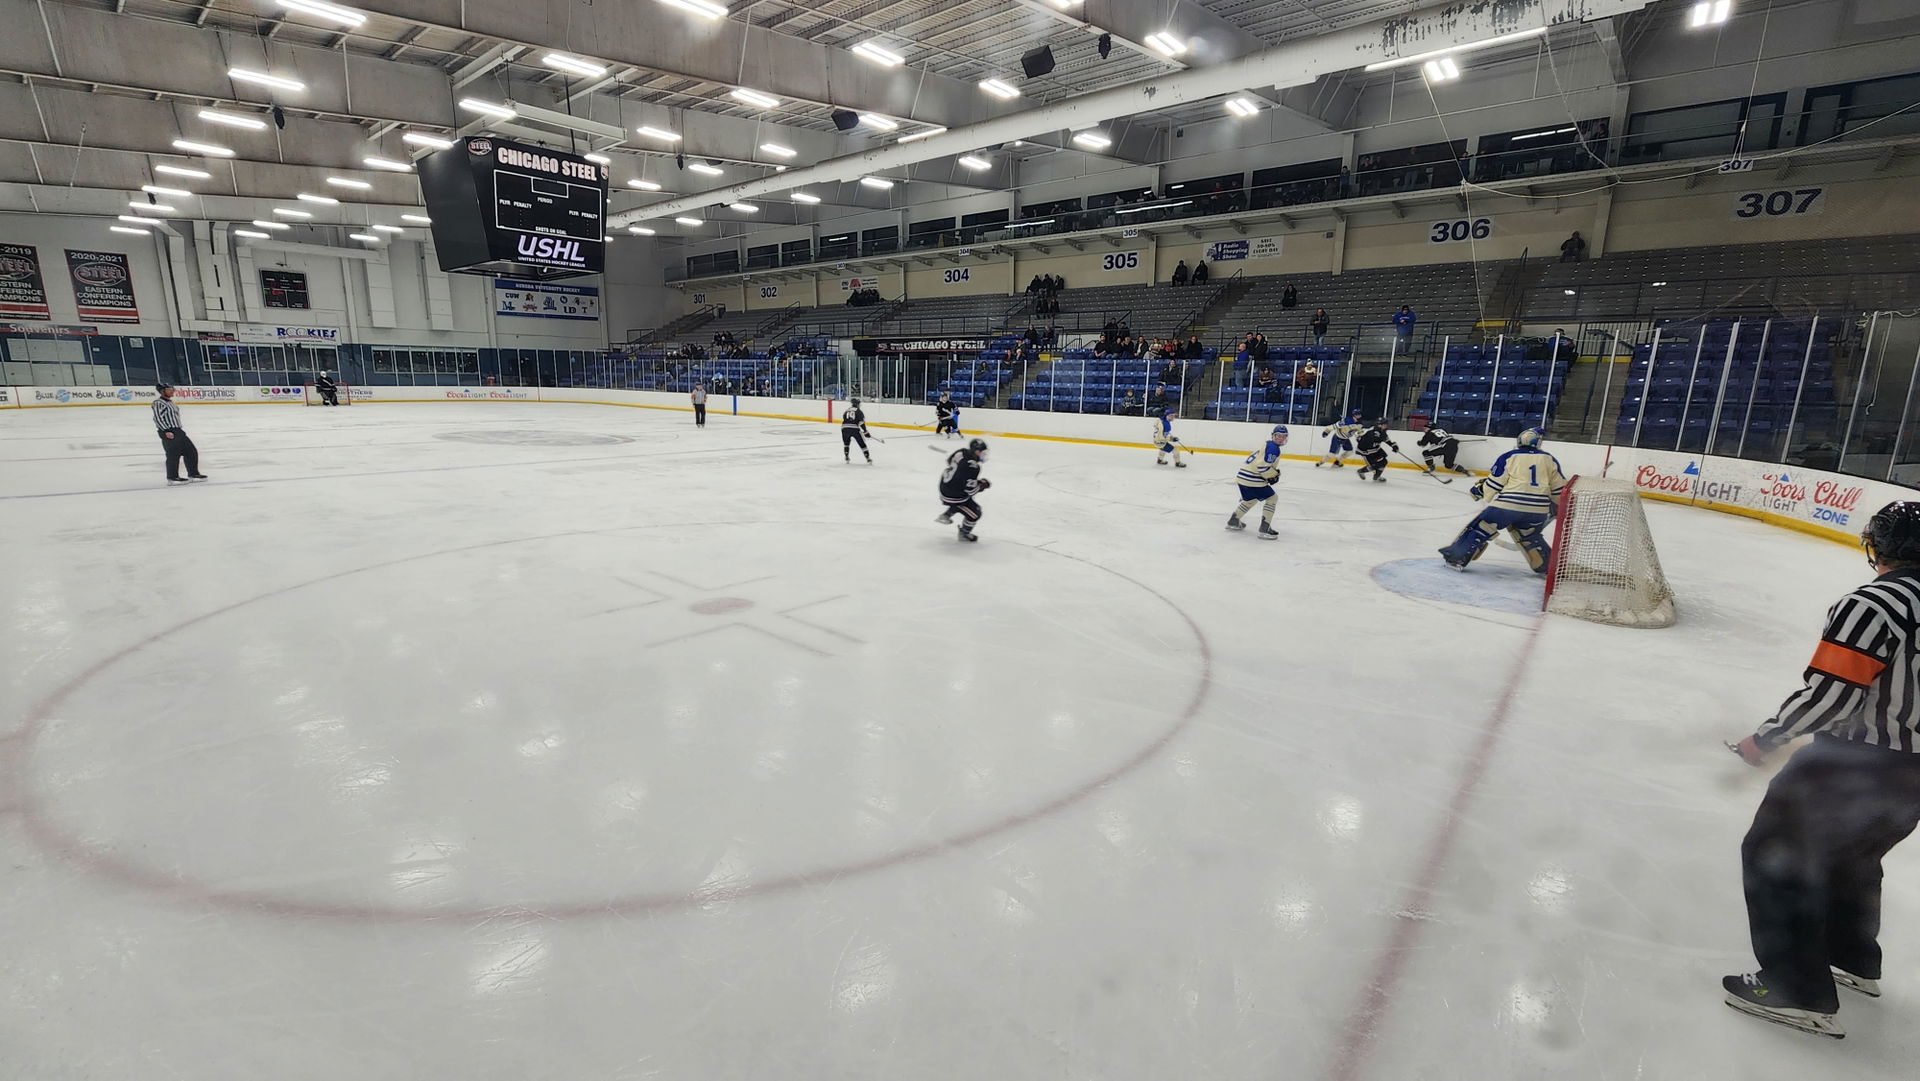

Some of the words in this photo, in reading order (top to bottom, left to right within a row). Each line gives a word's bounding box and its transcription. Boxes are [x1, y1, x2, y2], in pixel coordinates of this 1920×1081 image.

[470, 142, 491, 150] STEEL
[497, 147, 559, 174] CHICAGO
[561, 160, 598, 181] STEEL
[1720, 160, 1753, 171] 307
[513, 201, 532, 209] PENALTY
[1737, 188, 1822, 218] 307
[1123, 229, 1138, 237] 305
[1430, 218, 1491, 243] 306
[518, 235, 585, 261] USHL
[71, 252, 123, 263] 2020-2021
[1103, 252, 1138, 270] 305
[79, 266, 122, 279] STEEL
[944, 268, 970, 283] 304
[84, 286, 123, 294] EASTERN
[761, 286, 777, 298] 302
[77, 292, 134, 301] CONFERENCE
[693, 294, 706, 304] 301
[81, 299, 132, 307] CHAMPIONS
[9, 323, 71, 335] Souvenirs
[276, 327, 337, 338] ROOKIES
[903, 340, 949, 350] CHICAGO
[950, 340, 986, 350] STEEL
[35, 391, 54, 399] BLUE
[96, 390, 115, 399] BLUE
[175, 388, 236, 399] alphagraphics
[1529, 464, 1539, 487] 1
[1635, 465, 1689, 494] Coors
[1691, 479, 1742, 502] LIGHT
[1760, 474, 1806, 501] Coors
[1813, 480, 1864, 512] Chill
[1762, 494, 1798, 513] LIGHT
[1812, 507, 1849, 525] ZONE
